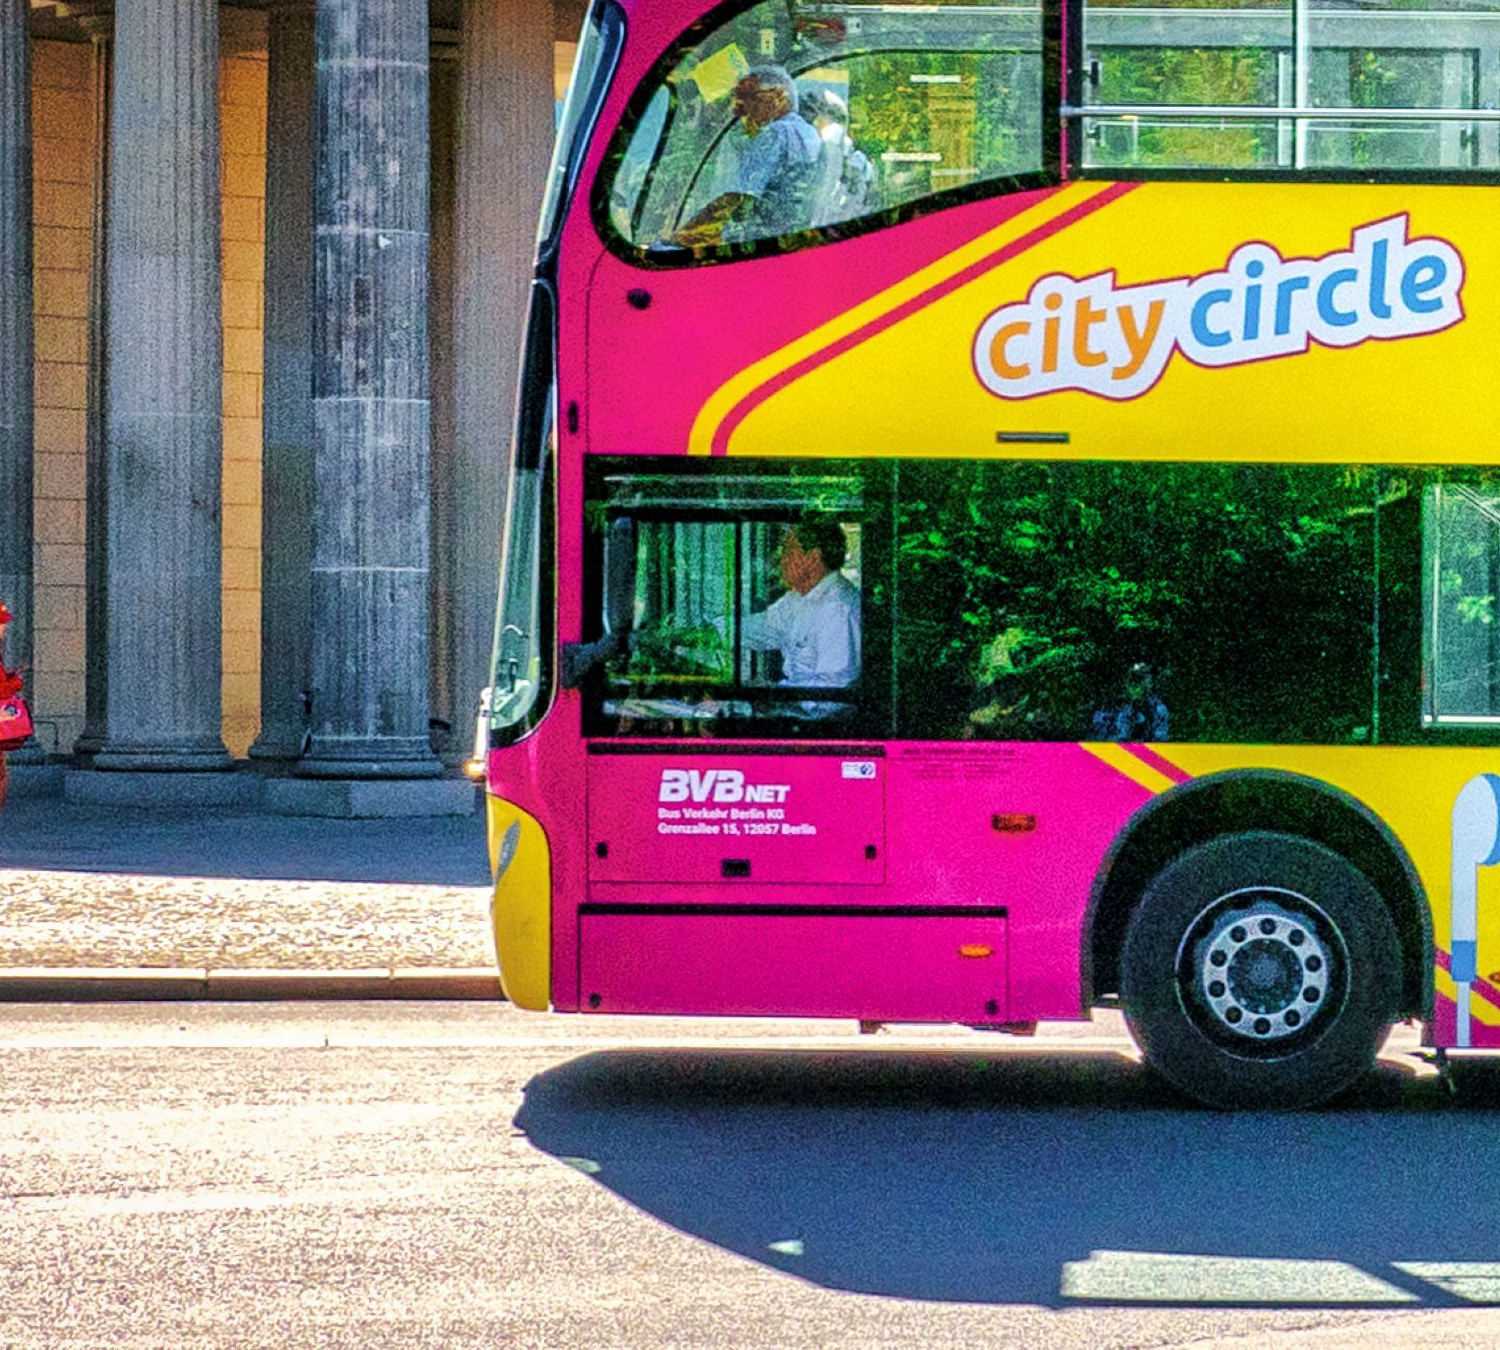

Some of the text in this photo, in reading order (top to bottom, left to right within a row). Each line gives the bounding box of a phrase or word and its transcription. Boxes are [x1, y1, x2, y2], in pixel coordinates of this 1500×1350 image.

[657, 808, 681, 819] Bus
[683, 807, 729, 819] Verkehr
[731, 808, 766, 820] Berlin
[722, 823, 741, 836] 15,
[743, 823, 779, 835] 12057
[781, 823, 817, 835] Berlin
